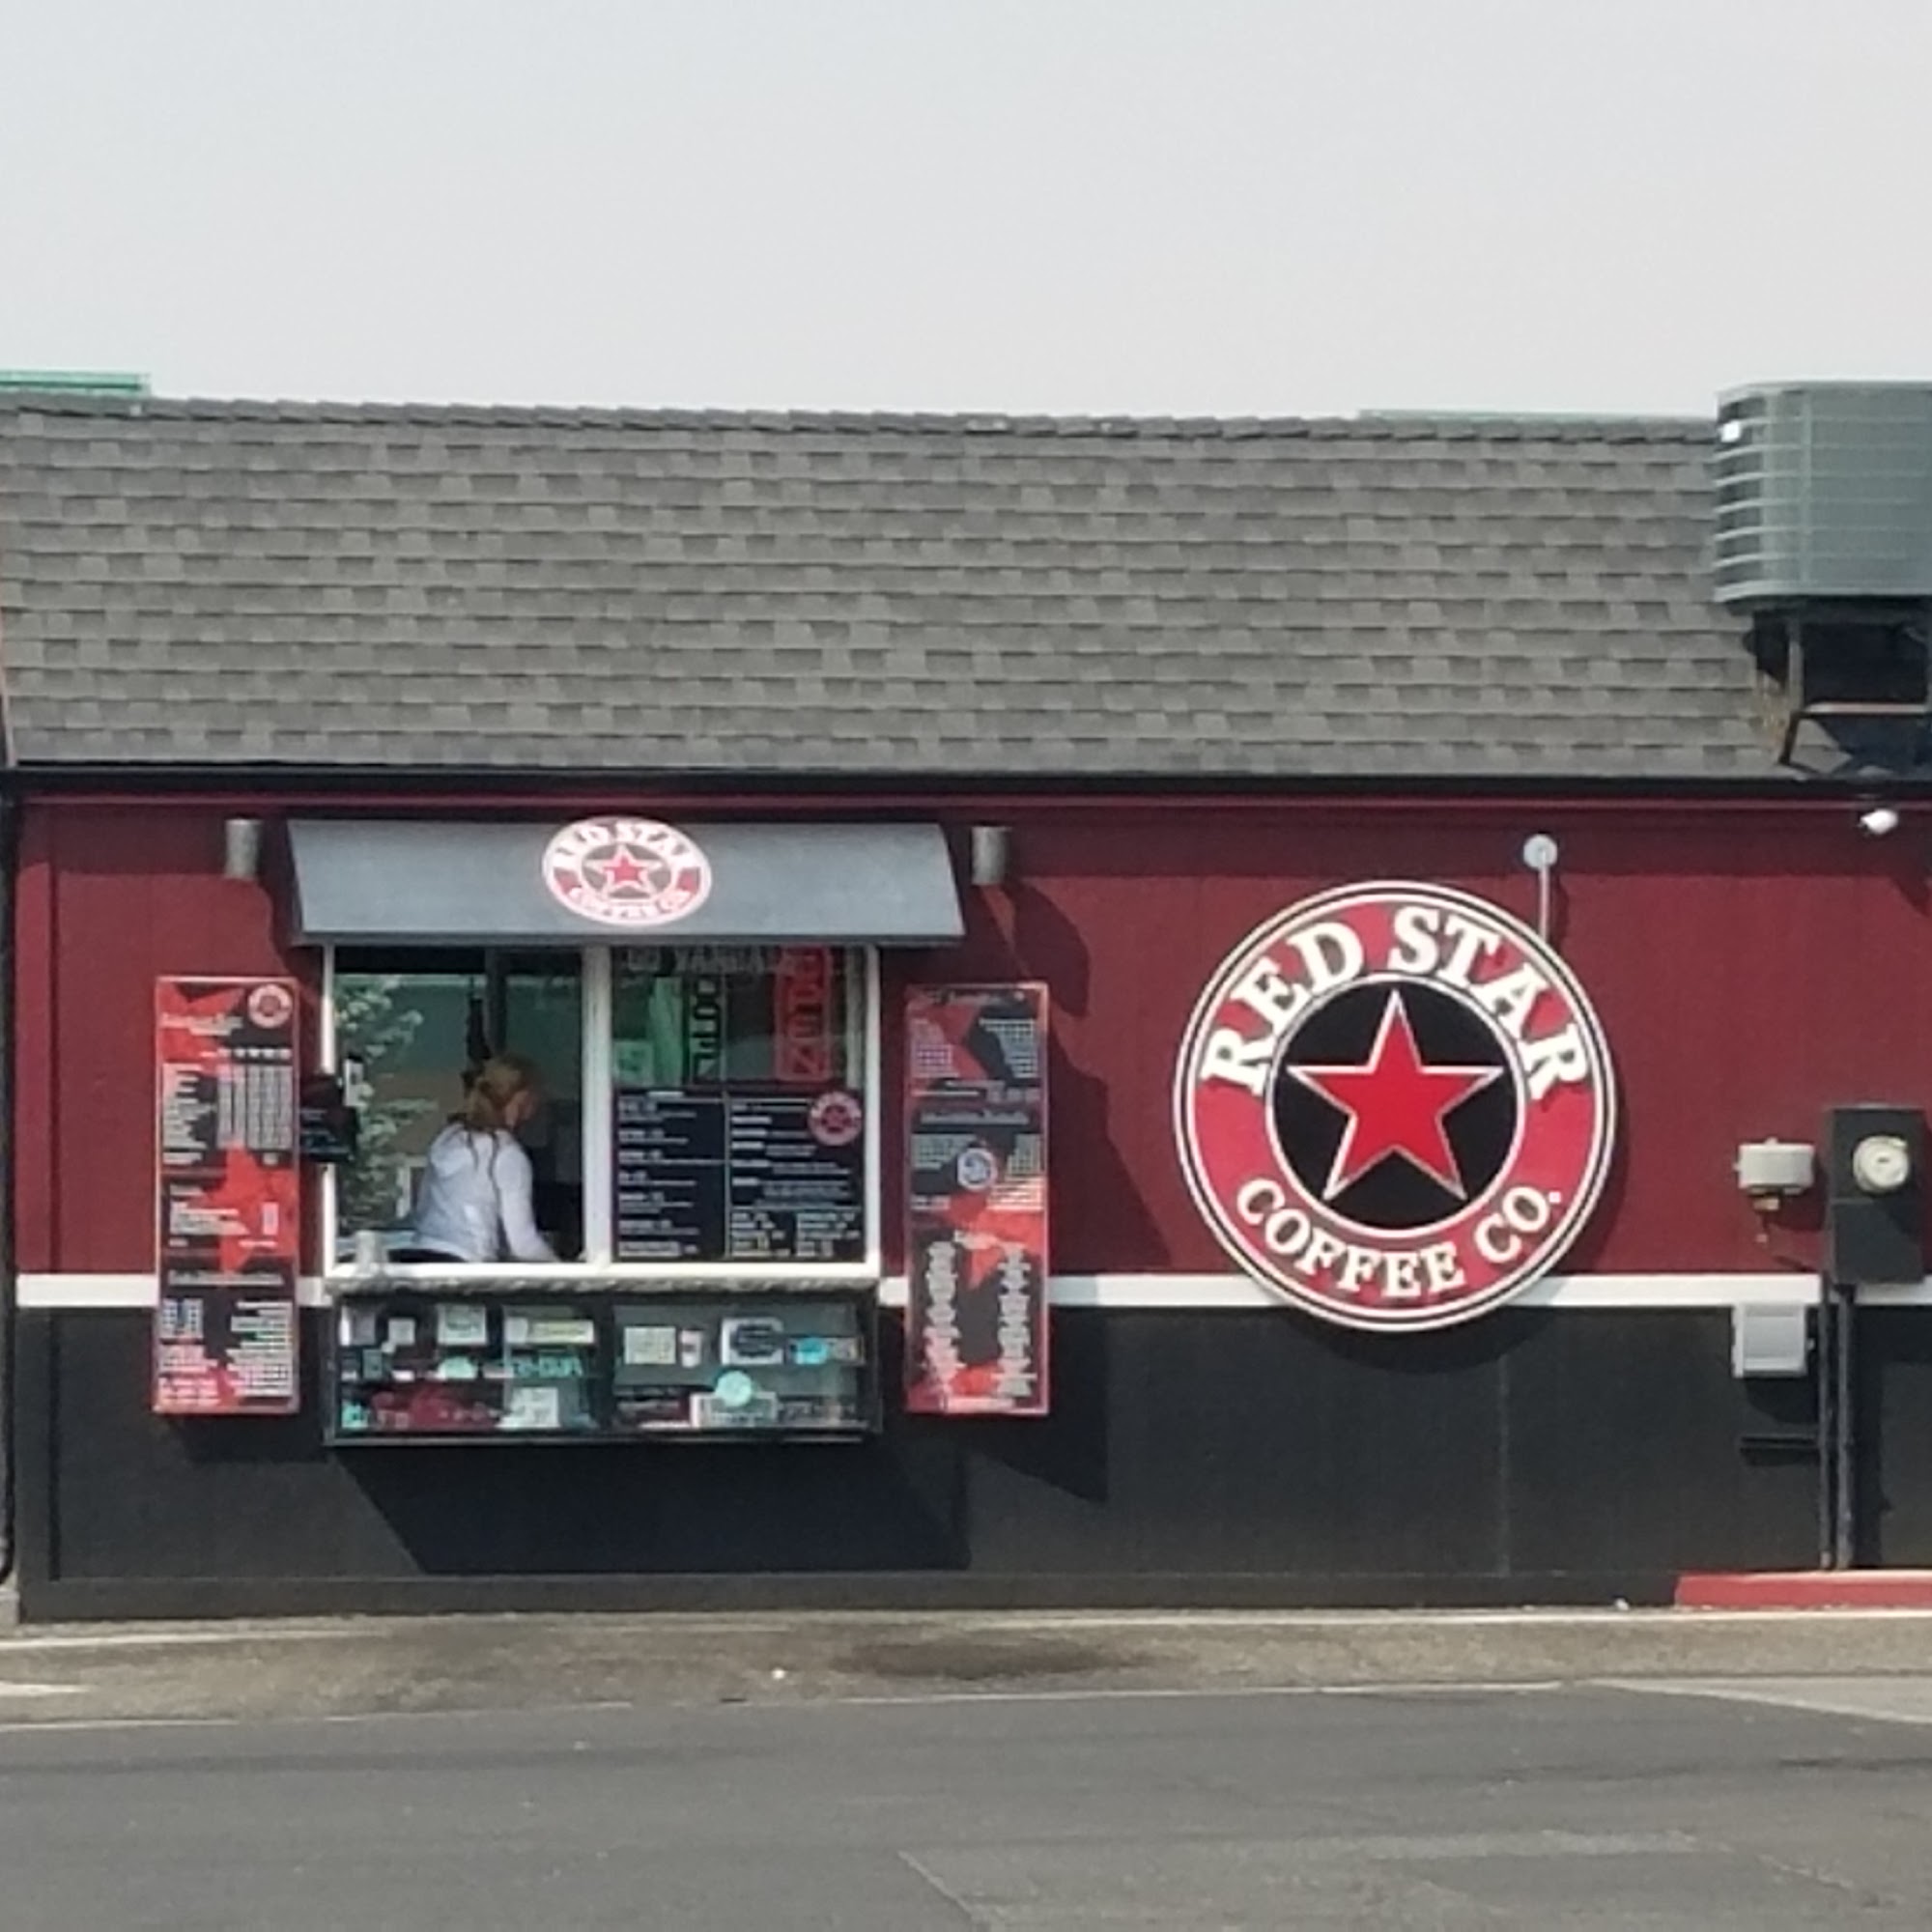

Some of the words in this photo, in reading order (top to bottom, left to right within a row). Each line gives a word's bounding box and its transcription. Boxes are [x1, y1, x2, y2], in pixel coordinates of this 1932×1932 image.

[1201, 920, 1364, 1096] RED
[1388, 905, 1589, 1100] STAR
[1236, 1179, 1466, 1298] COFFEE
[1474, 1185, 1562, 1263] CO.
